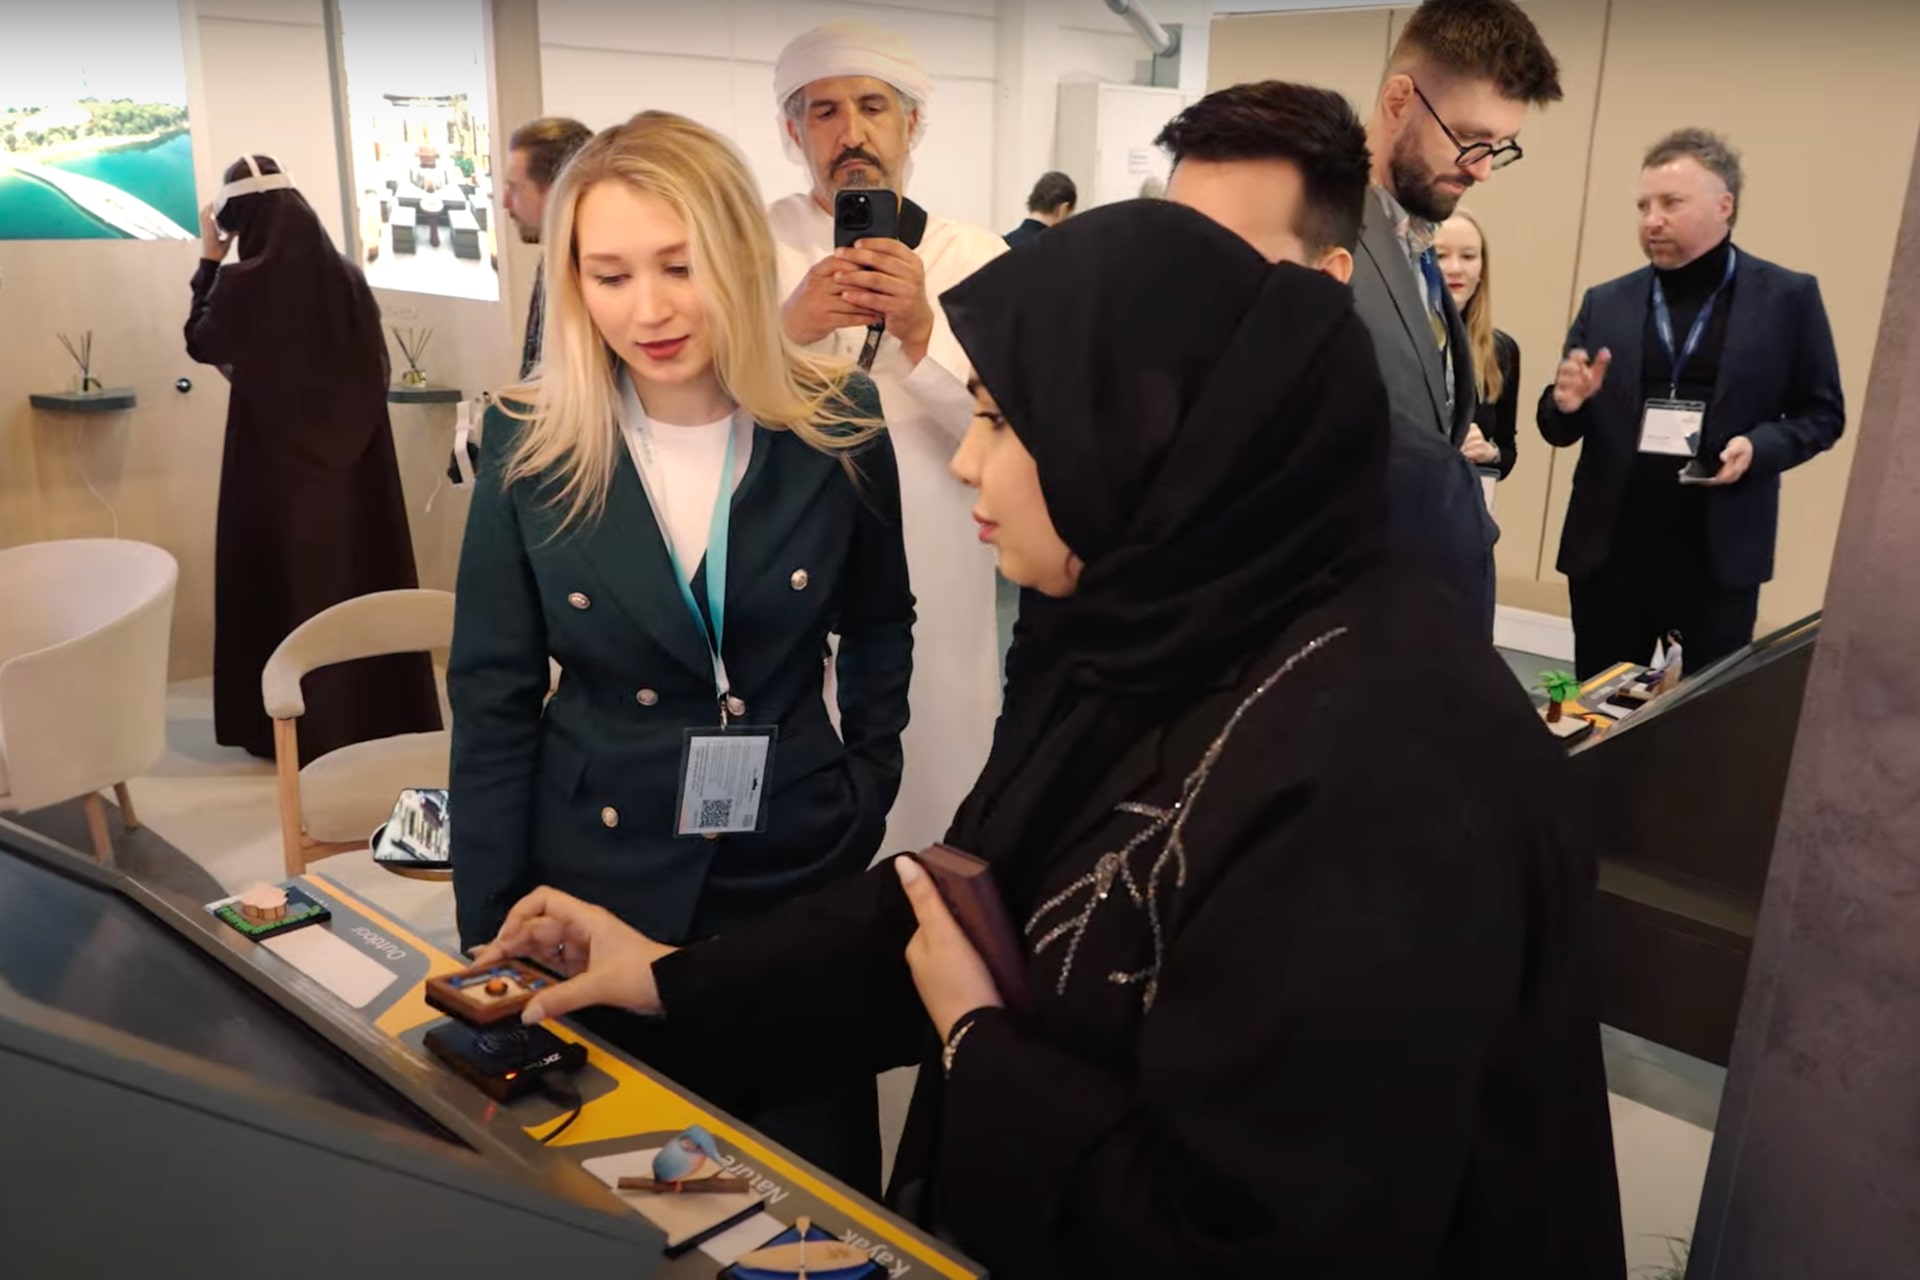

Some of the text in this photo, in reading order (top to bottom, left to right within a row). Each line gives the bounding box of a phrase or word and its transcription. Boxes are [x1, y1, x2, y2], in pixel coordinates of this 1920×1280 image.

[350, 926, 407, 960] Outdoor
[719, 1153, 790, 1205] Nature
[838, 1228, 912, 1280] Kayak
